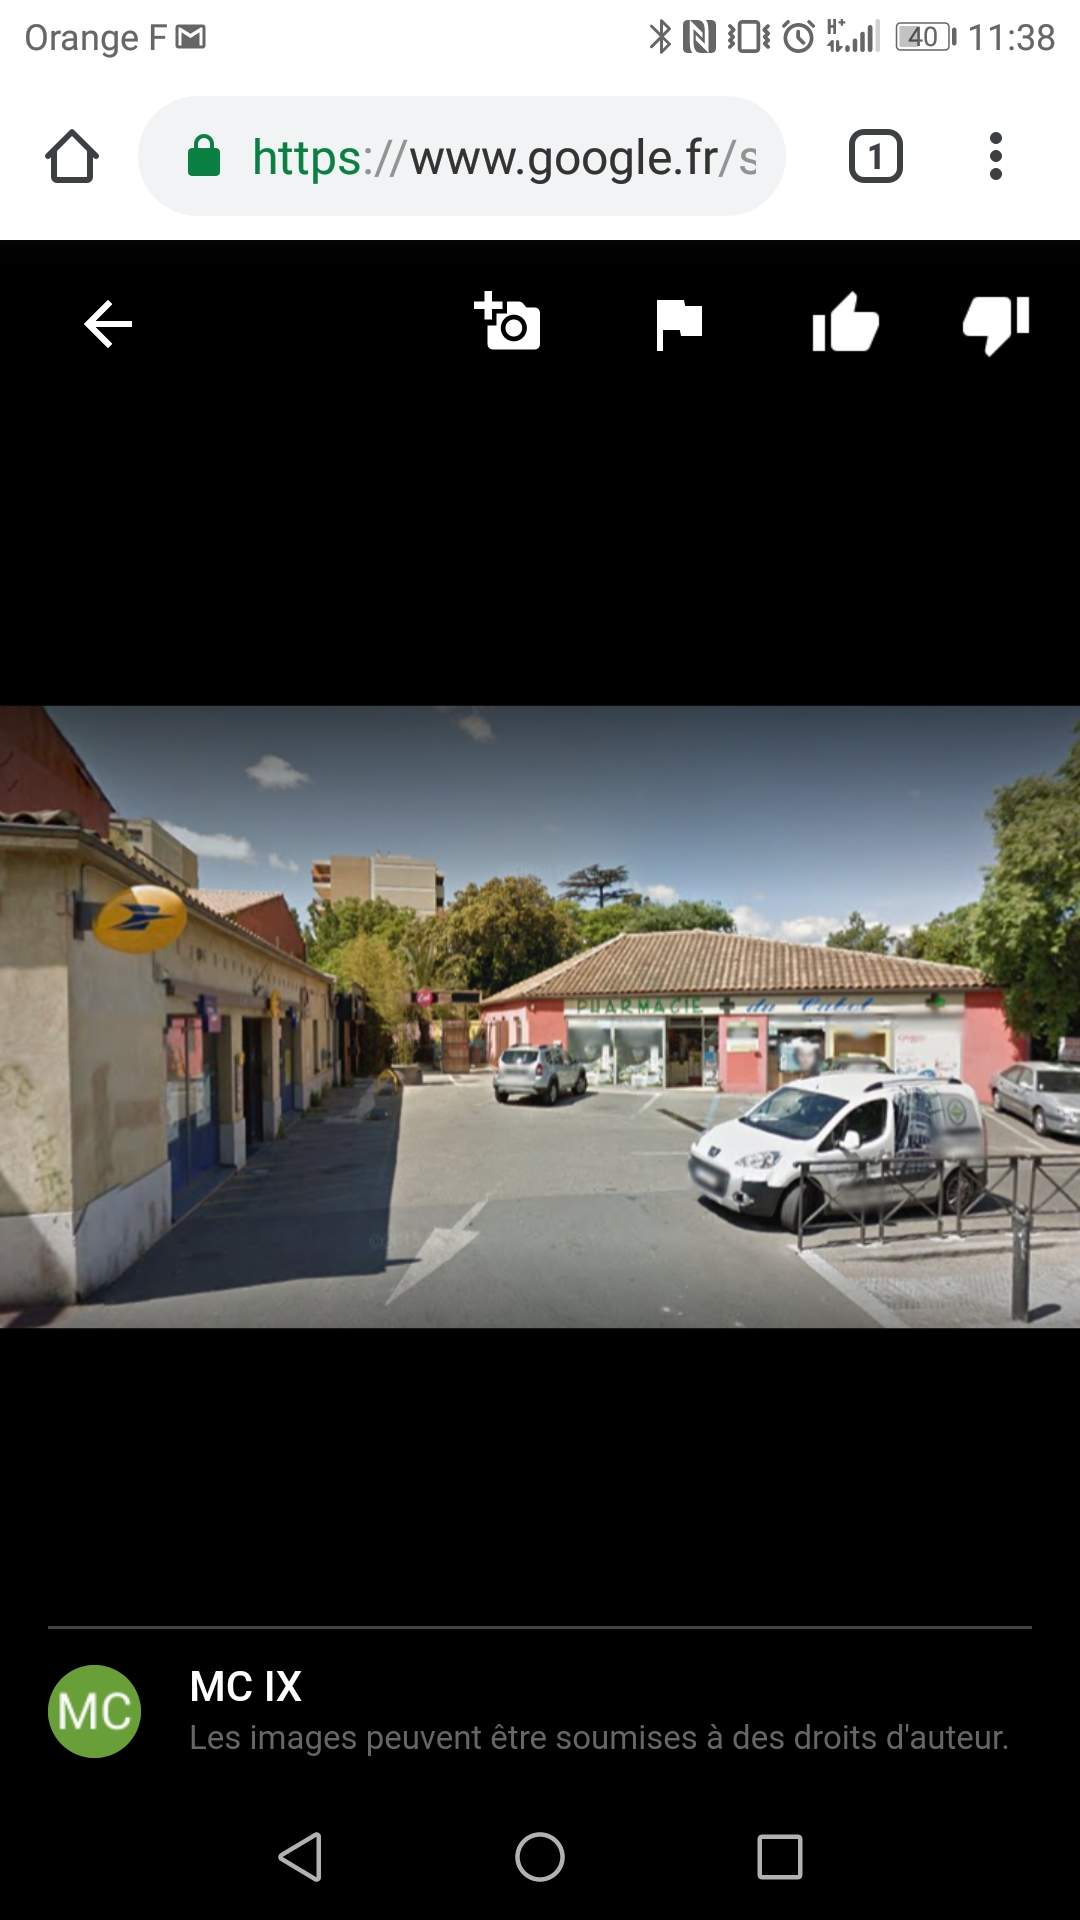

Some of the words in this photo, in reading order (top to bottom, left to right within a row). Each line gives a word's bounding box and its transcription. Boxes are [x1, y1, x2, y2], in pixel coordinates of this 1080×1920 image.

[25, 23, 139, 58] Orange
[150, 23, 168, 51] F
[907, 26, 938, 48] 40
[969, 23, 1056, 52] 11:38
[253, 137, 757, 185] https://www.google.fr/s
[869, 142, 881, 170] 1
[576, 996, 704, 1015] PHARMACIE
[191, 1670, 253, 1702] MC
[266, 1670, 303, 1702] IX
[56, 1692, 132, 1731] MC
[191, 1724, 241, 1751] Les
[251, 1724, 357, 1757] images
[367, 1725, 482, 1757] peuvent
[491, 1723, 547, 1751] être
[556, 1724, 697, 1751] soumises
[707, 1723, 723, 1751] à
[732, 1723, 785, 1751] des
[794, 1723, 877, 1751] droits
[886, 1723, 1009, 1751] d'auteur.
